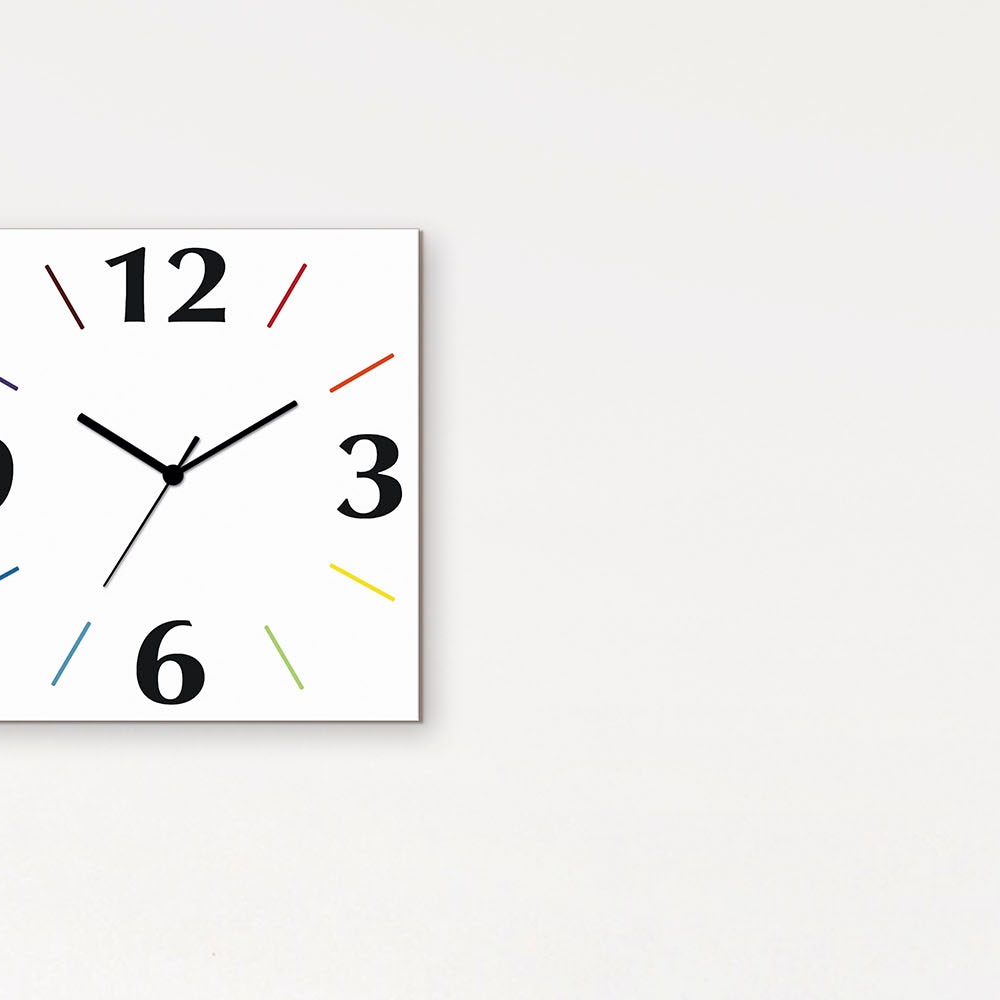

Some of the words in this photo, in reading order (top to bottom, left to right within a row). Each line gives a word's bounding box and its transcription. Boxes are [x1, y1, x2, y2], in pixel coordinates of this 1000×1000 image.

[105, 247, 226, 323] 12
[337, 434, 403, 519] 3
[136, 620, 205, 705] 6
